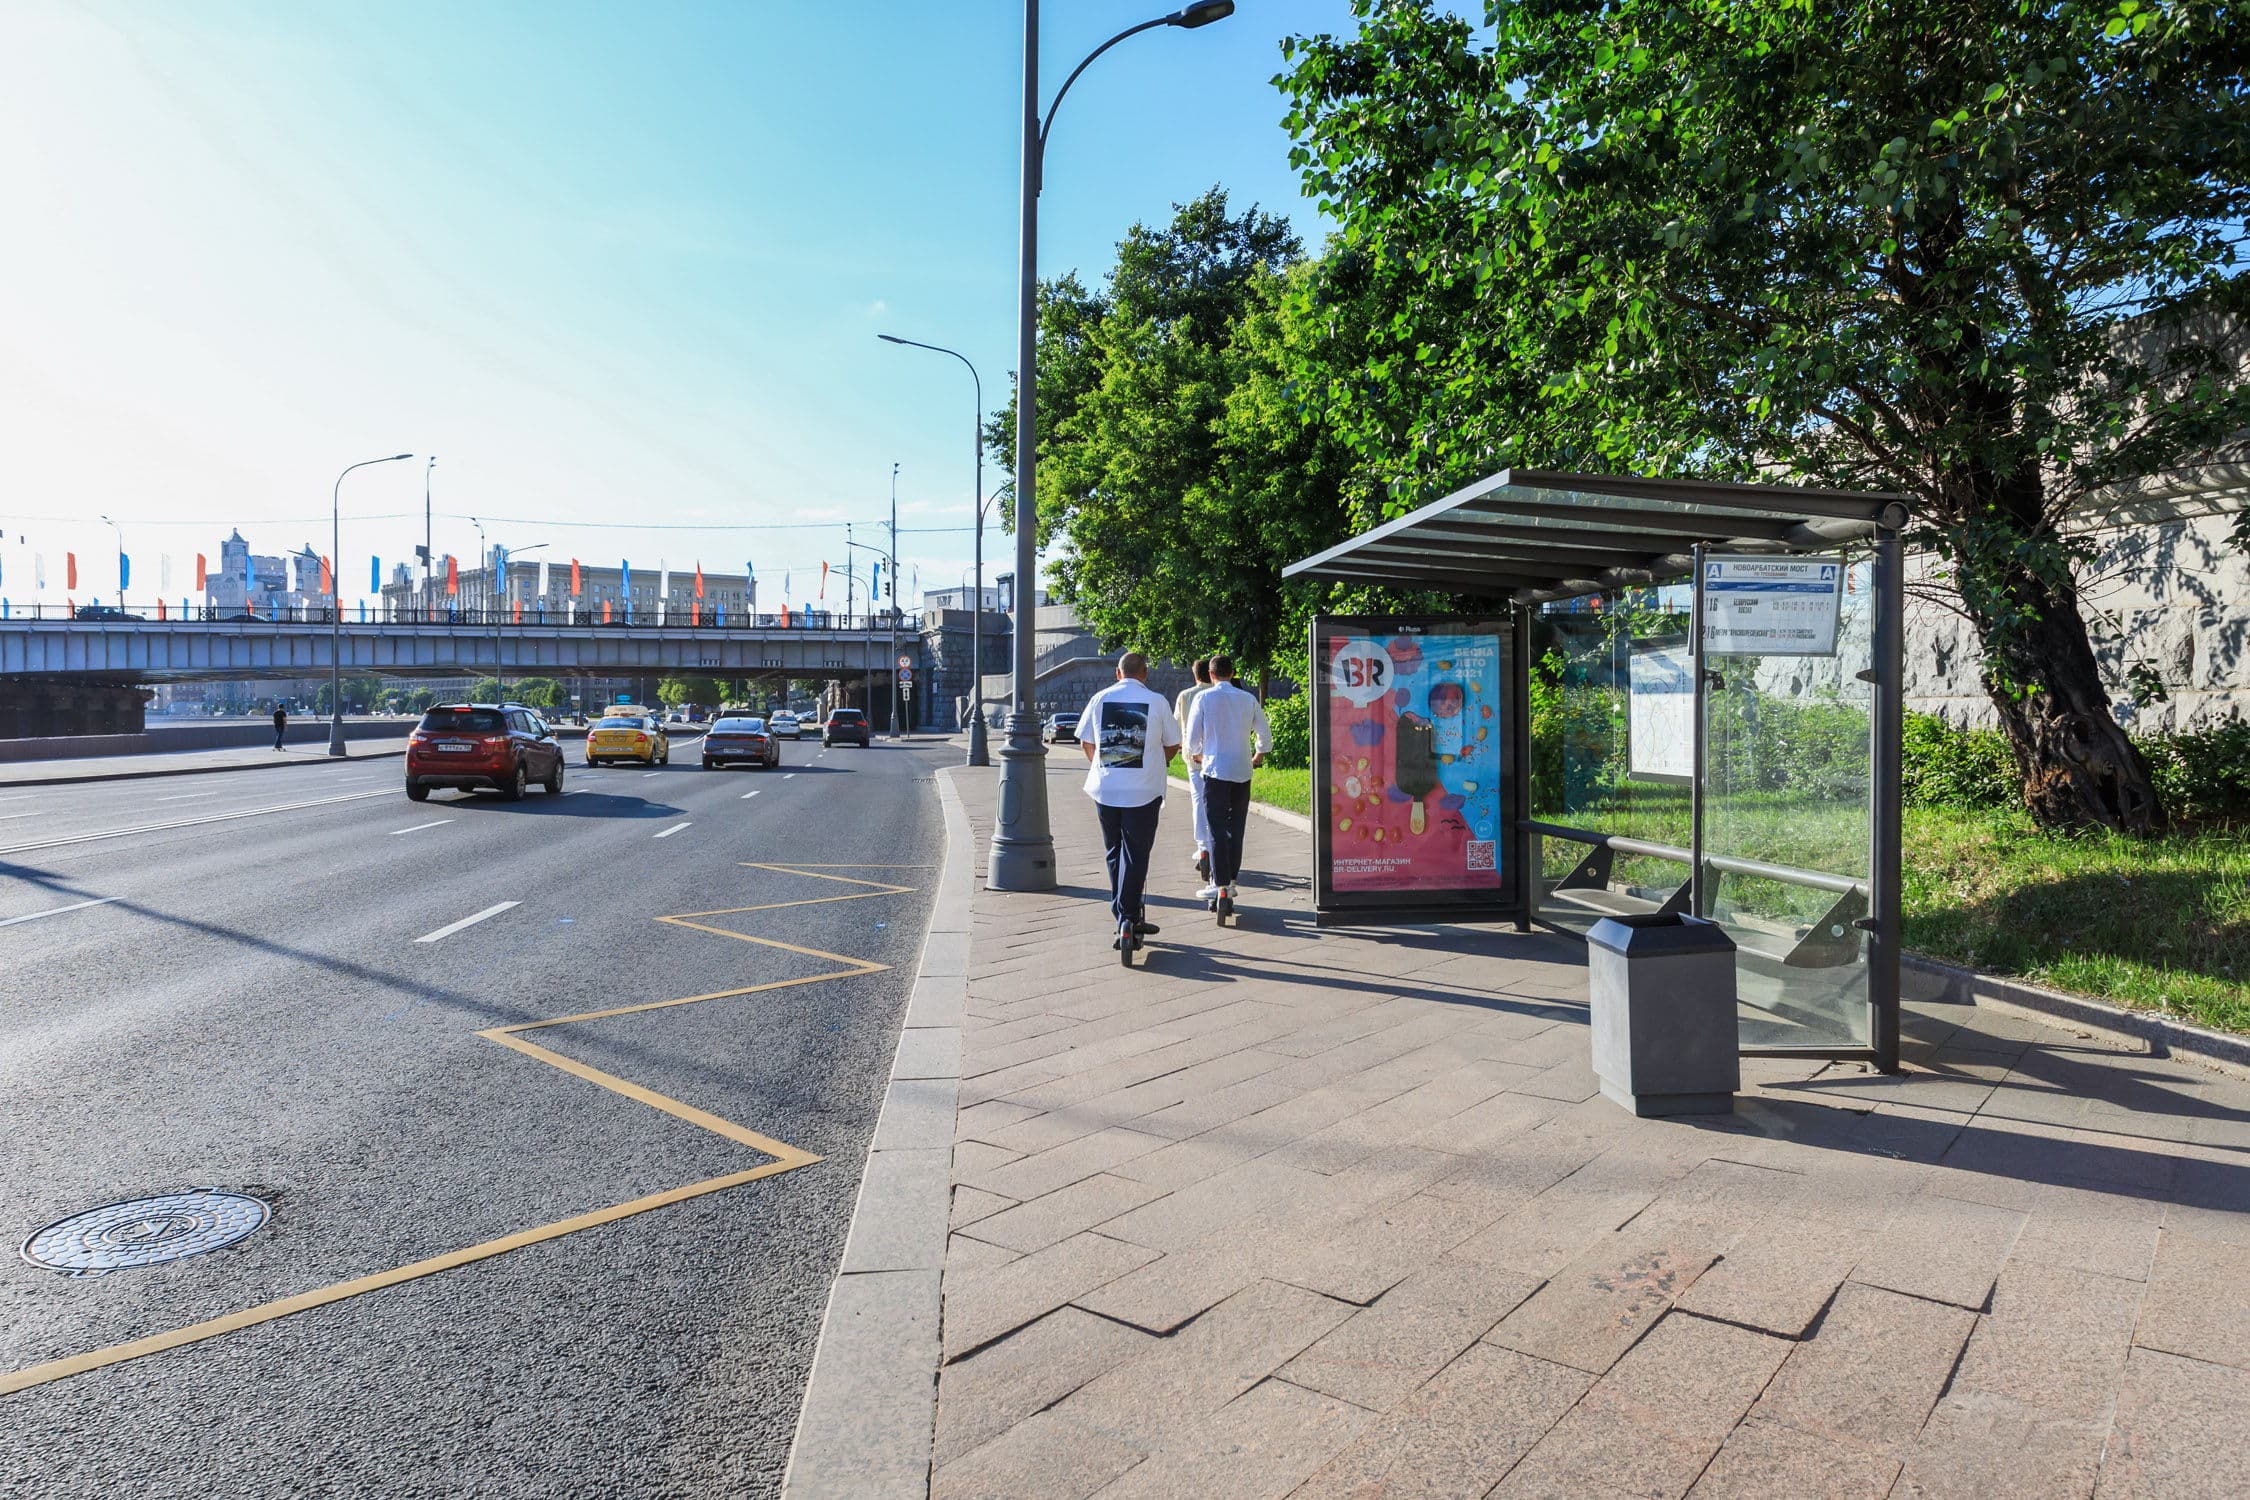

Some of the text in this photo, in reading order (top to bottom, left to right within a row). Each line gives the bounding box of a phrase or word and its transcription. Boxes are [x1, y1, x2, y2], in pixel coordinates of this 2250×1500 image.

[1733, 564, 1789, 572] НОВОАРБАТСКИЙ
[1454, 648, 1494, 657] ВЕСНА
[1455, 658, 1486, 667] ЛЕТО
[1341, 657, 1385, 687] BR
[1455, 669, 1483, 678] 2021
[1333, 858, 1411, 866] ИНТЕРНЕТ-МАГАЗИН
